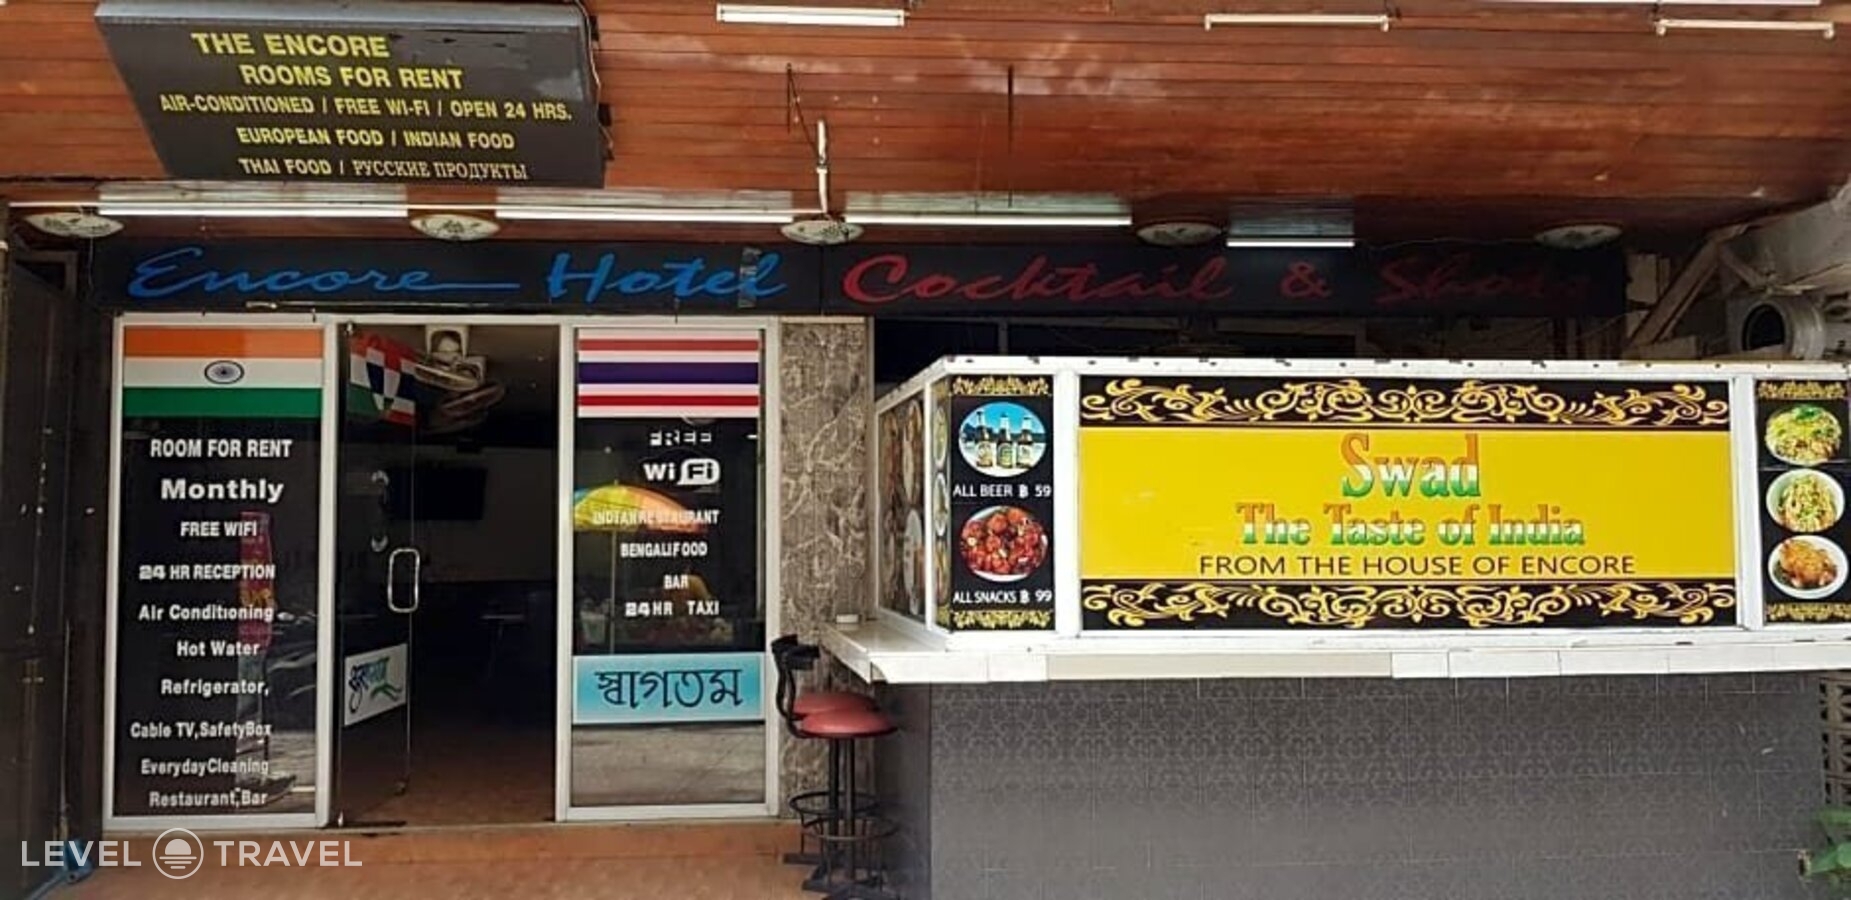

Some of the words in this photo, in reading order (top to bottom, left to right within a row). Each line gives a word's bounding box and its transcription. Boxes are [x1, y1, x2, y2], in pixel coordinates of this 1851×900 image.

[191, 33, 255, 55] THE
[263, 34, 390, 58] ENCORE
[239, 64, 332, 86] ROOMS
[340, 66, 392, 88] FOR
[398, 68, 463, 90] RENT
[160, 94, 314, 114] AIR-CONDITIONED
[334, 97, 381, 116] FREE
[386, 99, 431, 117] WI-FI
[450, 101, 499, 118] OPEN
[503, 102, 526, 119] 24
[532, 102, 573, 121] HRS.
[236, 127, 332, 145] EUROPEAN
[335, 129, 384, 146] FOOD
[403, 130, 462, 148] INDIAN
[467, 133, 515, 149] FOOD
[239, 158, 280, 174] THAI
[284, 159, 332, 175] FOOD
[352, 160, 432, 178] РУССКИЕ
[433, 163, 528, 180] ПРОДУКТЫ
[127, 246, 520, 298] Encore
[547, 252, 787, 303] Hotel
[842, 254, 1234, 303] Cocktail
[1281, 261, 1333, 297] &
[150, 439, 201, 457] ROOM
[207, 439, 241, 457] FOR
[247, 439, 292, 458] RENT
[1341, 433, 1481, 498] Swad
[160, 479, 284, 503] Monthly
[952, 483, 977, 498] ALL
[980, 483, 1013, 498] BEER
[1034, 483, 1052, 498] 59
[180, 521, 219, 537] FREE
[224, 521, 257, 537] WIFI
[1236, 502, 1312, 545] The
[1323, 503, 1426, 546] Taste
[1438, 504, 1480, 546] of
[1488, 504, 1585, 545] India
[139, 565, 166, 580] 24
[169, 565, 190, 580] HR
[193, 565, 275, 580] RECEPTION
[1200, 556, 1285, 575] FROM
[1296, 556, 1351, 575] THE
[1363, 556, 1462, 575] HOUSE
[1472, 556, 1510, 575] OF
[1521, 556, 1635, 575] ENCORE
[664, 574, 689, 590] BAR
[952, 588, 973, 604] ALL
[974, 588, 1017, 605] SNACKS
[1034, 588, 1053, 603] 99
[168, 604, 274, 622] Conditioning
[686, 600, 720, 616] TAXI
[176, 640, 206, 657] Hot
[210, 640, 260, 657] Water
[160, 679, 270, 698] Refrigerator,
[594, 669, 743, 710] স্বাগতম
[130, 721, 172, 738] Cable
